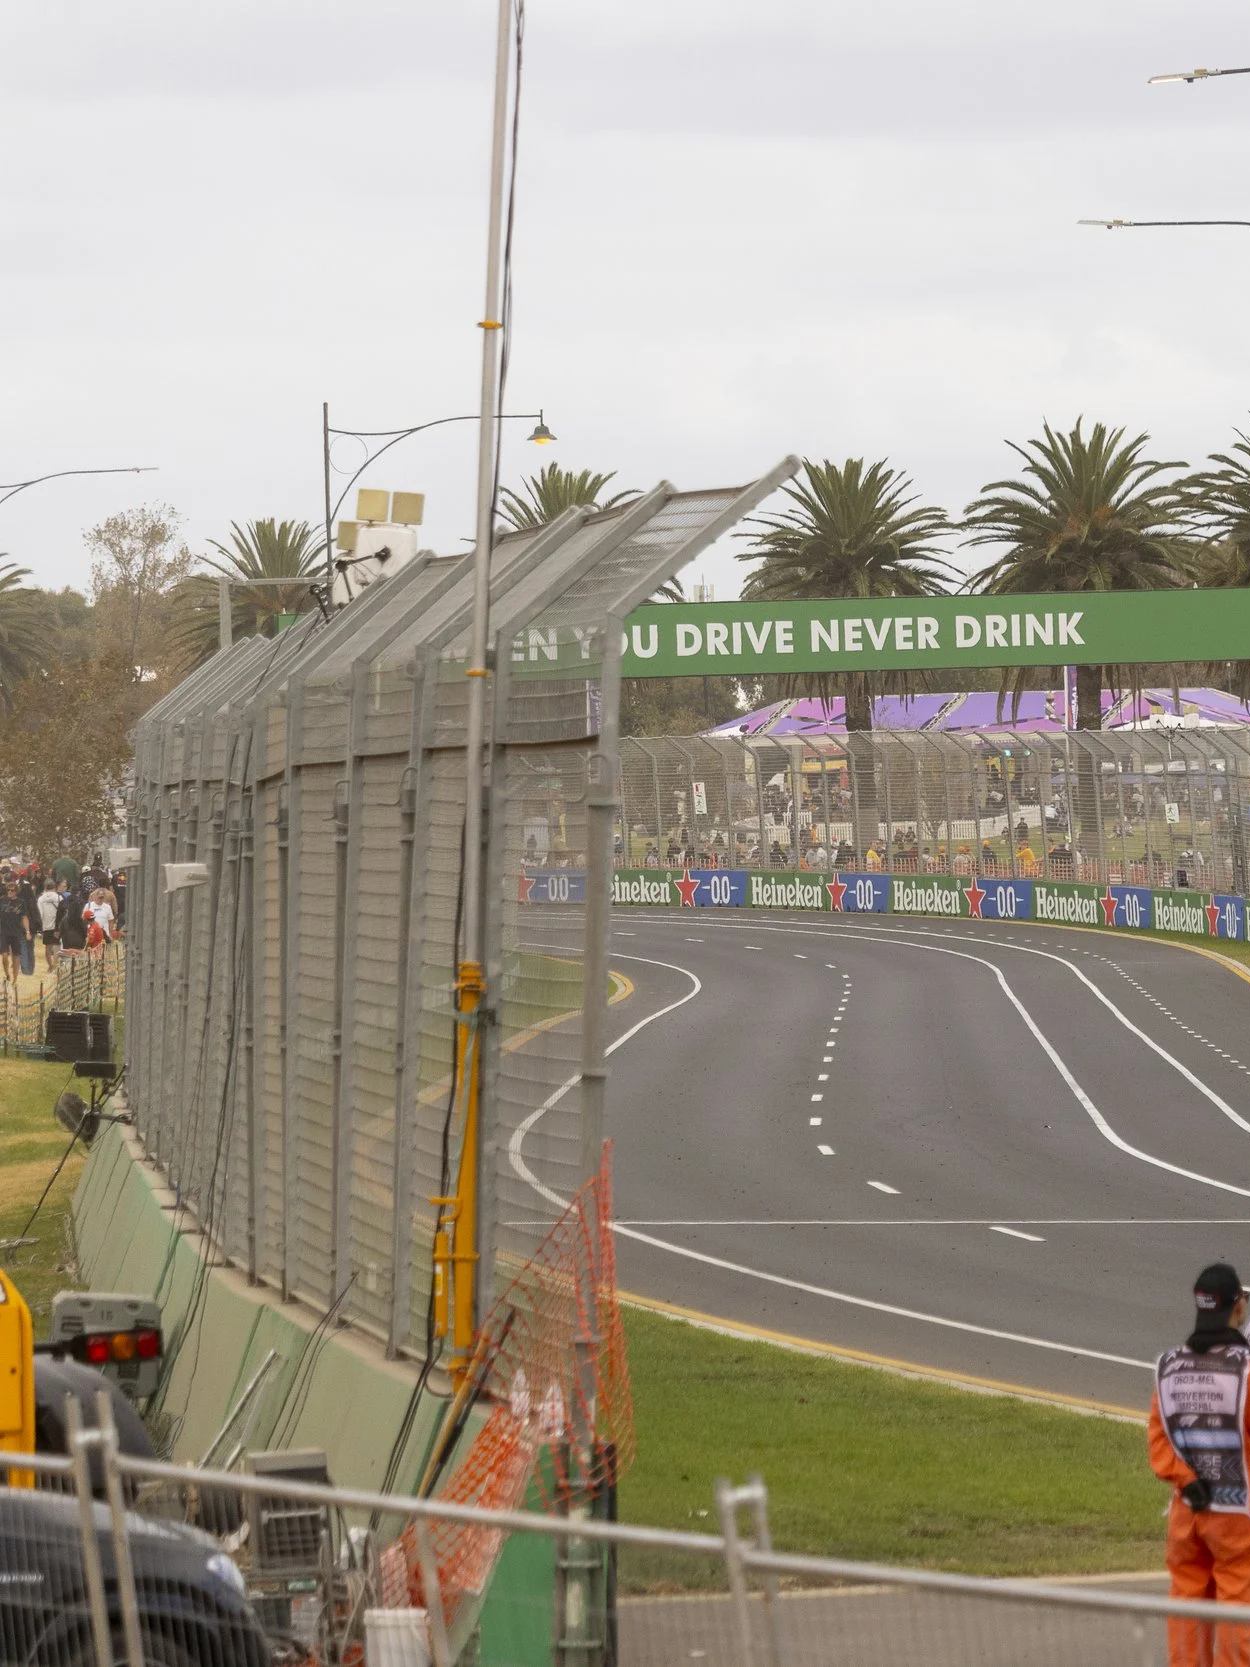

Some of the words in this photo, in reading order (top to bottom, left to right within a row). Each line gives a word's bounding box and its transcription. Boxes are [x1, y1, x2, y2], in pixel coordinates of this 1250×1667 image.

[676, 620, 795, 657] DRIVE
[810, 616, 941, 653] NEVER
[954, 611, 1086, 649] DRINK
[609, 874, 672, 904] ineken
[710, 875, 730, 904] 0.0
[751, 876, 824, 908] Heineken
[855, 879, 874, 910] 0.0
[893, 880, 961, 914] Heineken
[996, 885, 1016, 918] 0.0
[1034, 887, 1099, 925] Heineken
[1125, 893, 1140, 928] 0.0
[1153, 896, 1204, 934] Heineken
